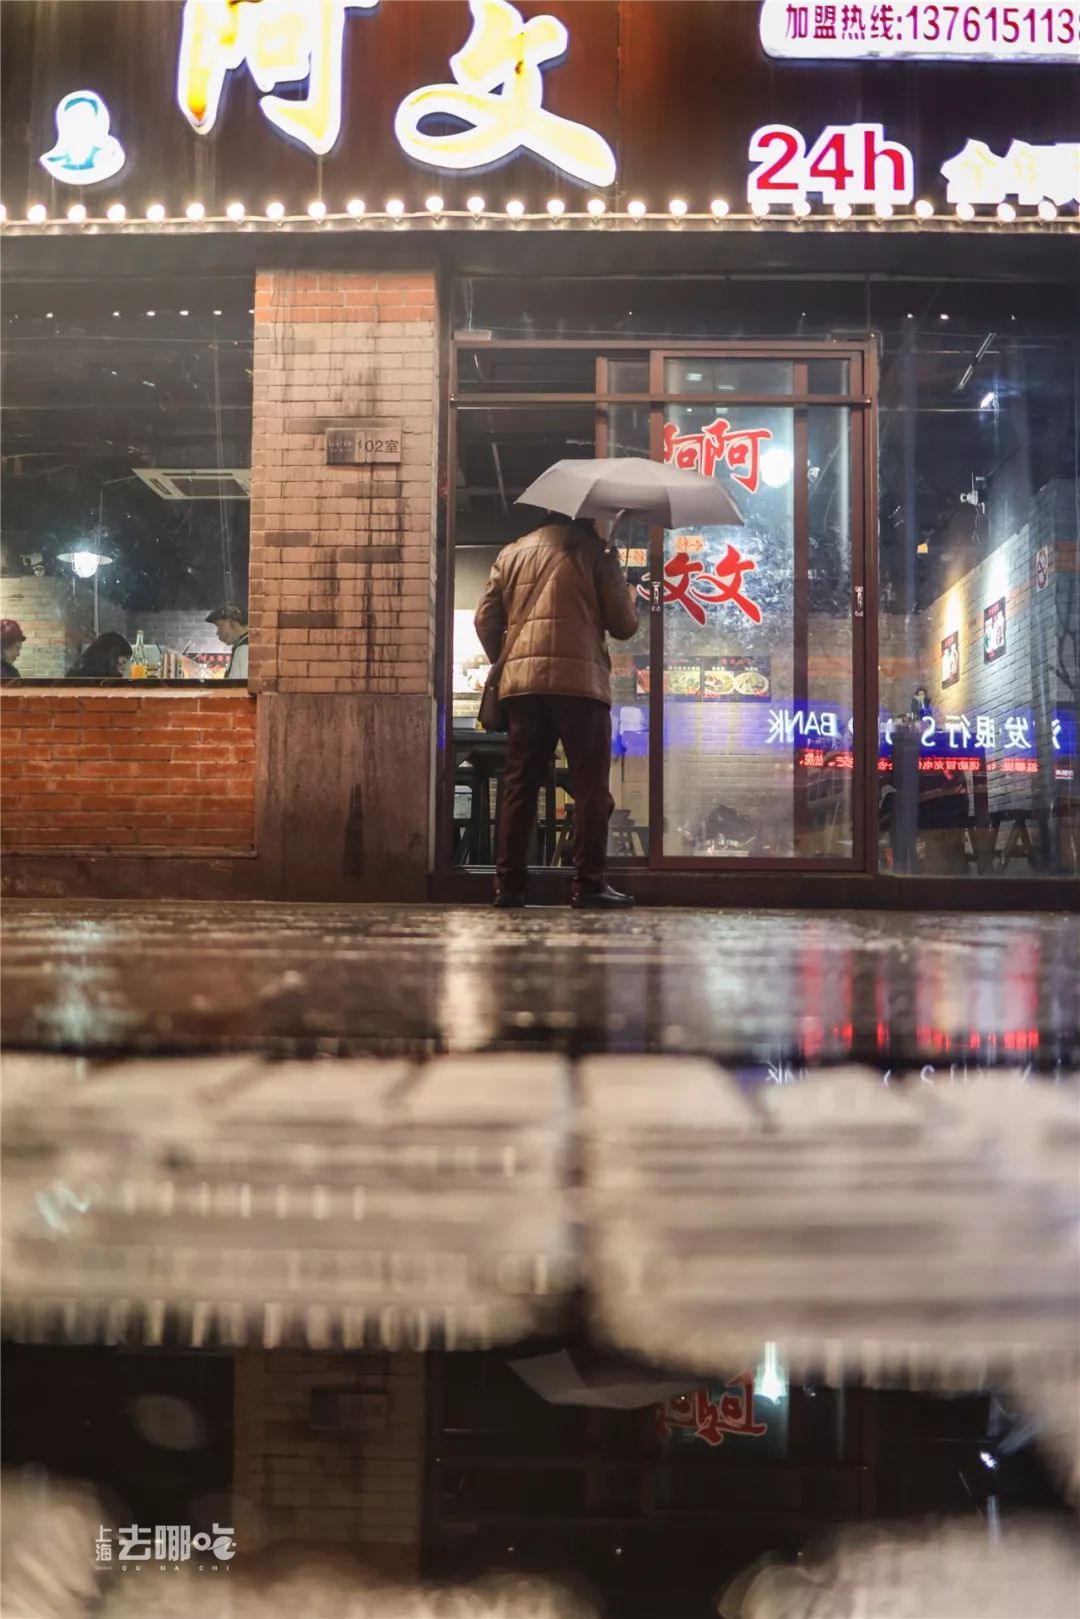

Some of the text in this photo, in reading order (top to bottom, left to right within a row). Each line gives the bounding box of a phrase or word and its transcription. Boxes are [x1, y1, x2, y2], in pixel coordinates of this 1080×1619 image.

[785, 4, 1080, 43] 加盟热线:137615113
[756, 130, 906, 190] 24h
